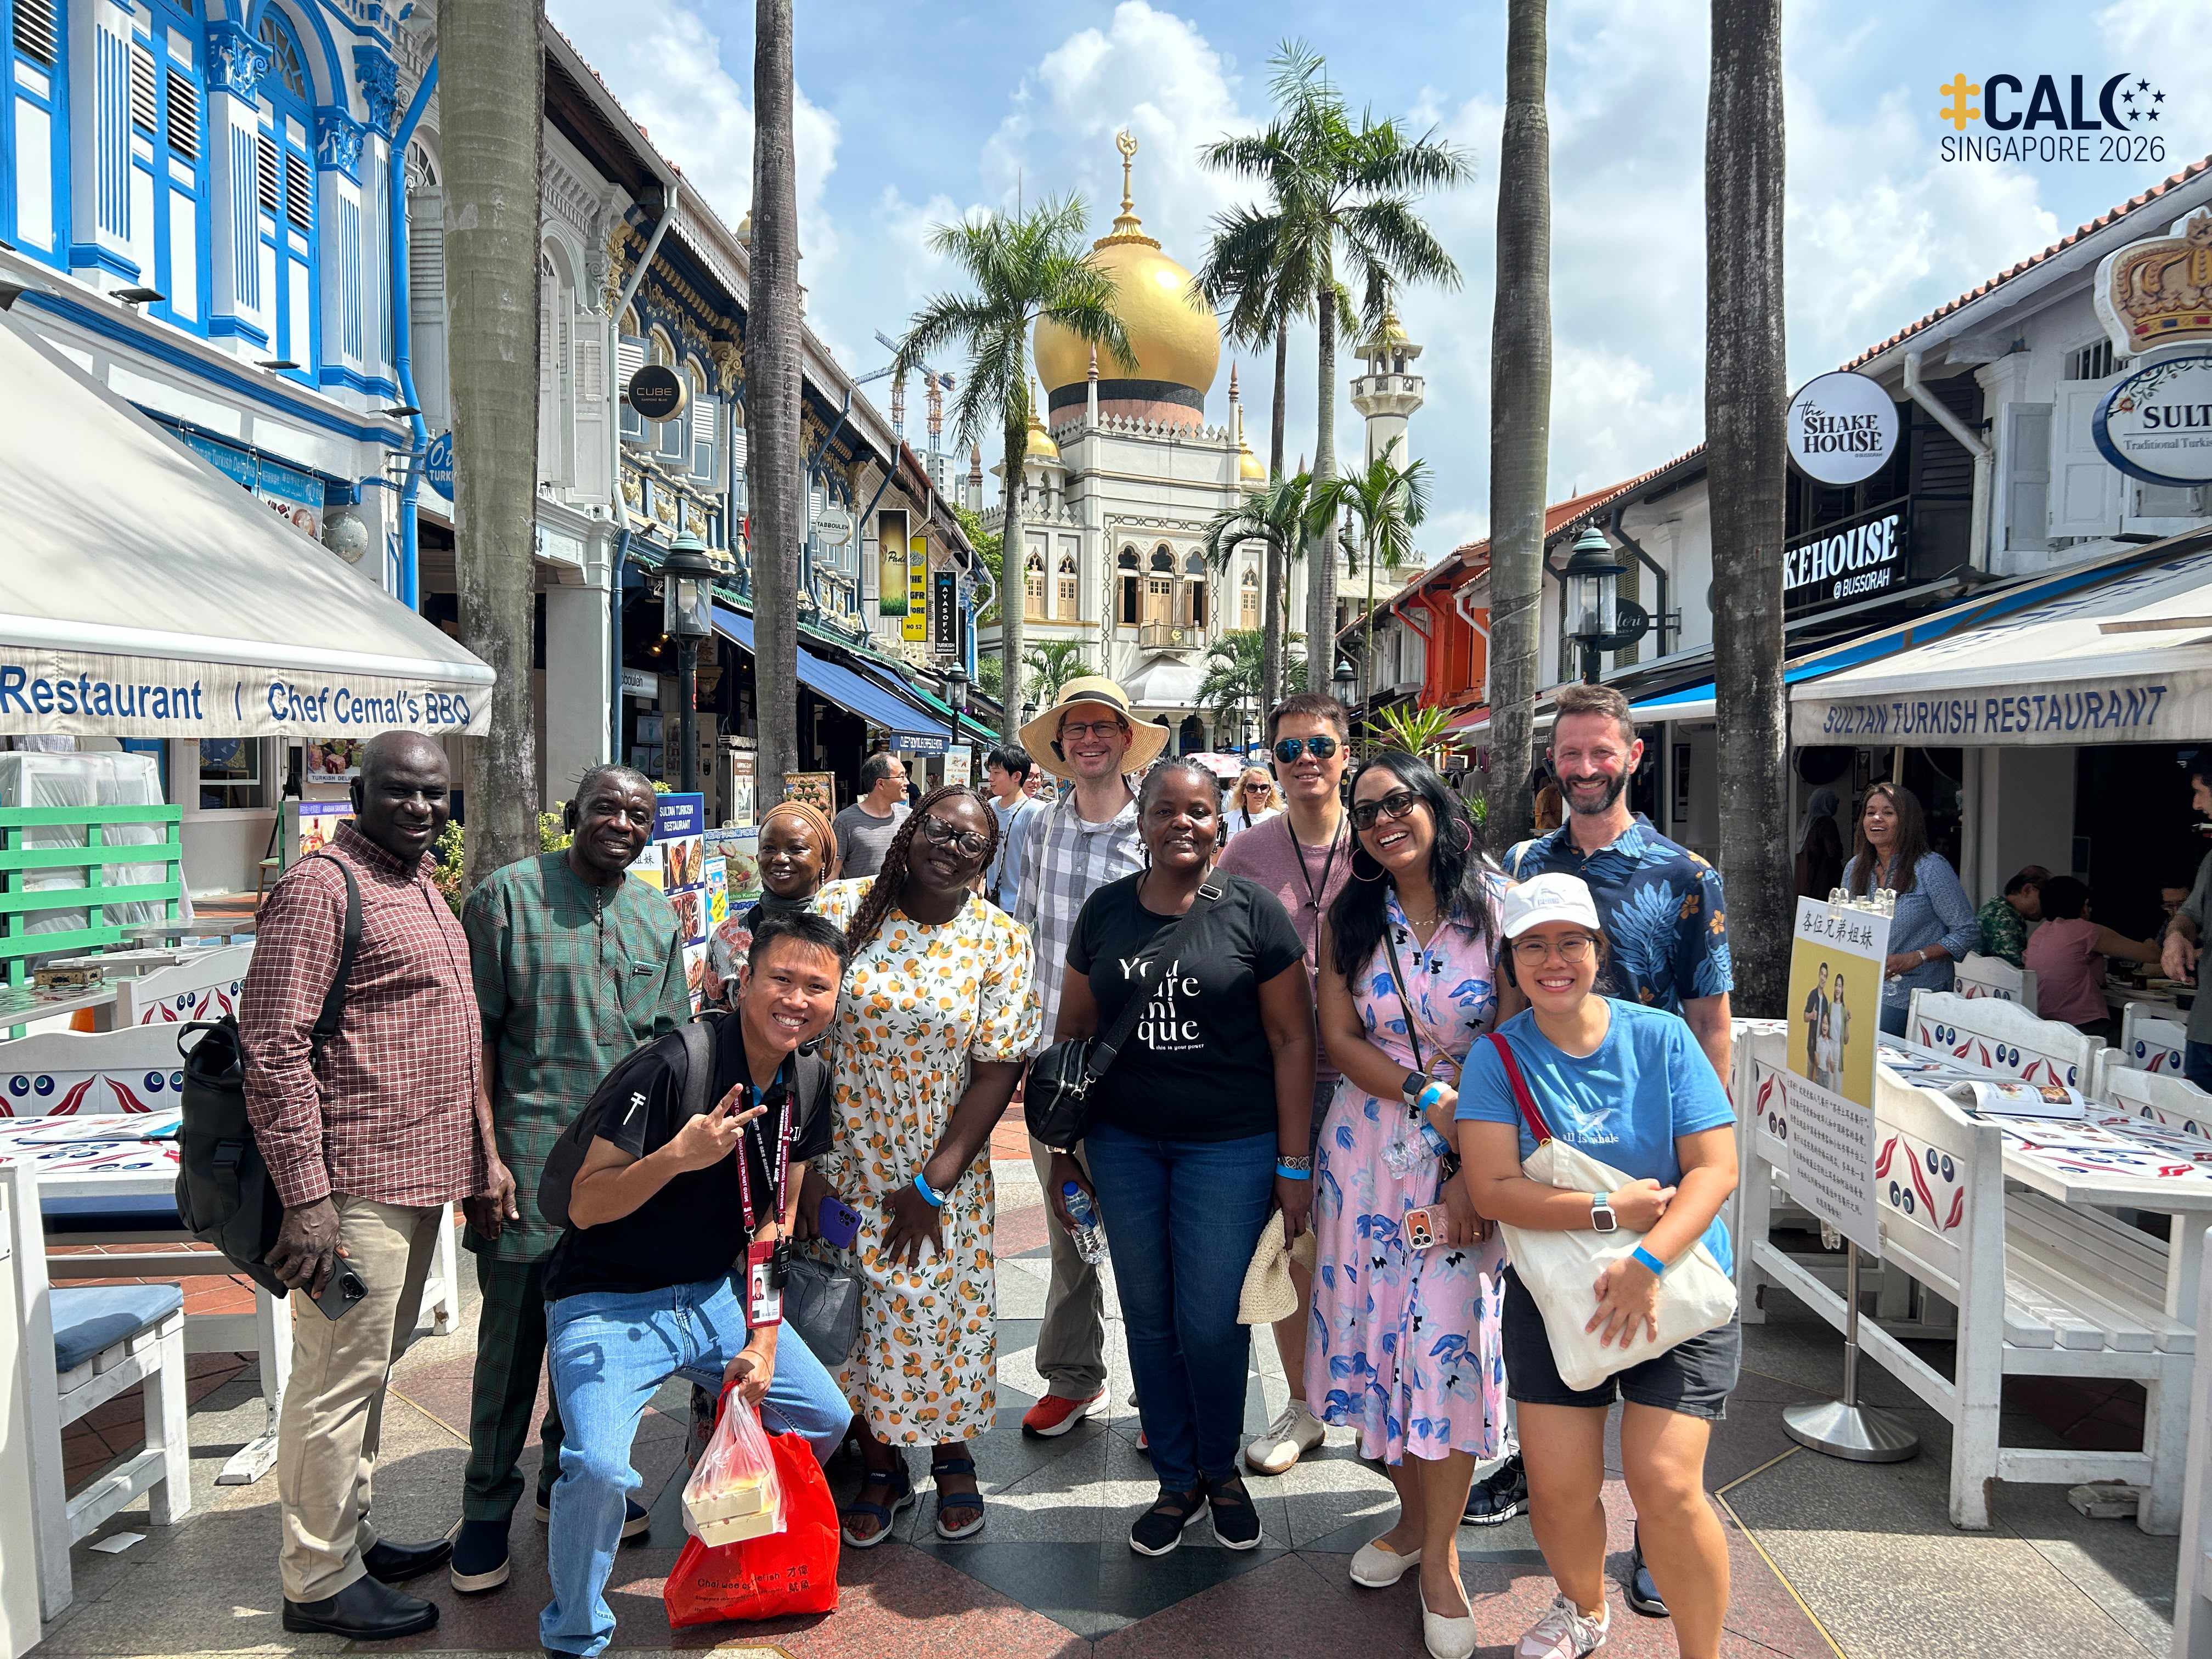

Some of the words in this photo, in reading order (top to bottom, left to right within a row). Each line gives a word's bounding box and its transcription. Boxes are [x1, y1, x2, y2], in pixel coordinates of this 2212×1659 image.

[636, 387, 672, 396] CUBE
[1804, 414, 1878, 435] SHAKE
[1803, 430, 1882, 454] HOUSE
[2124, 438, 2180, 450] Traditional
[817, 521, 849, 531] TABBOULEH
[0, 665, 203, 720] Restaurant
[267, 682, 330, 723] Chef
[334, 687, 419, 724] Cemal's
[425, 693, 471, 725] BBQ
[1823, 704, 1888, 733] SULTAN
[1892, 699, 1977, 733] TURKISH
[1984, 686, 2167, 733] RESTAURANT
[659, 805, 675, 817] SULTAN
[676, 804, 694, 816] TURKISH
[664, 819, 691, 832] RESTAURANT
[1803, 909, 1872, 950] 各位兄弟姐妹
[1139, 997, 1176, 1019] ni
[1137, 1020, 1200, 1049] que
[1562, 1132, 1575, 1142] all
[1577, 1133, 1588, 1143] is
[1589, 1133, 1620, 1144] whale
[697, 1578, 719, 1589] Chai
